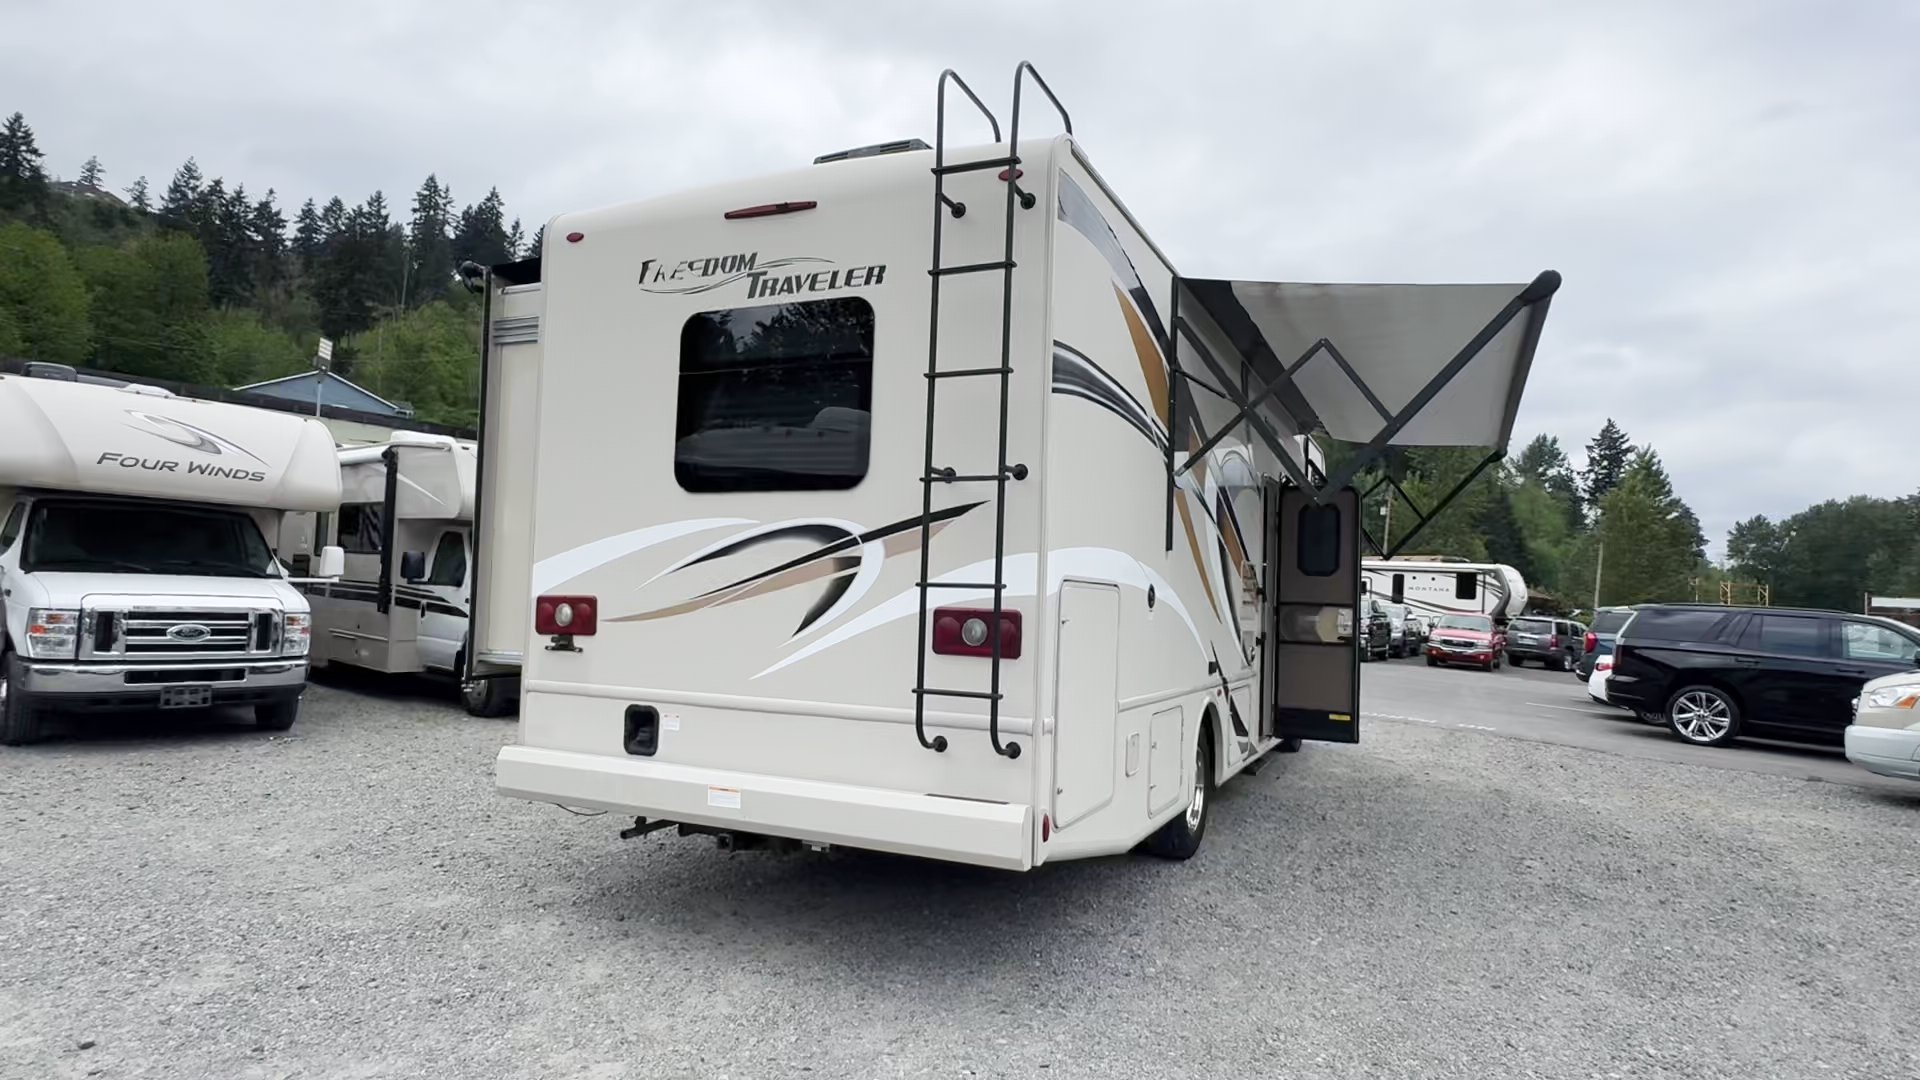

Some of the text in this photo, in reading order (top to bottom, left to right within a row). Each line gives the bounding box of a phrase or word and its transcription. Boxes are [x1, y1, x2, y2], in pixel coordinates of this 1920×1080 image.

[746, 264, 887, 299] TRAVELER
[96, 452, 266, 482] FOUR WINDS
